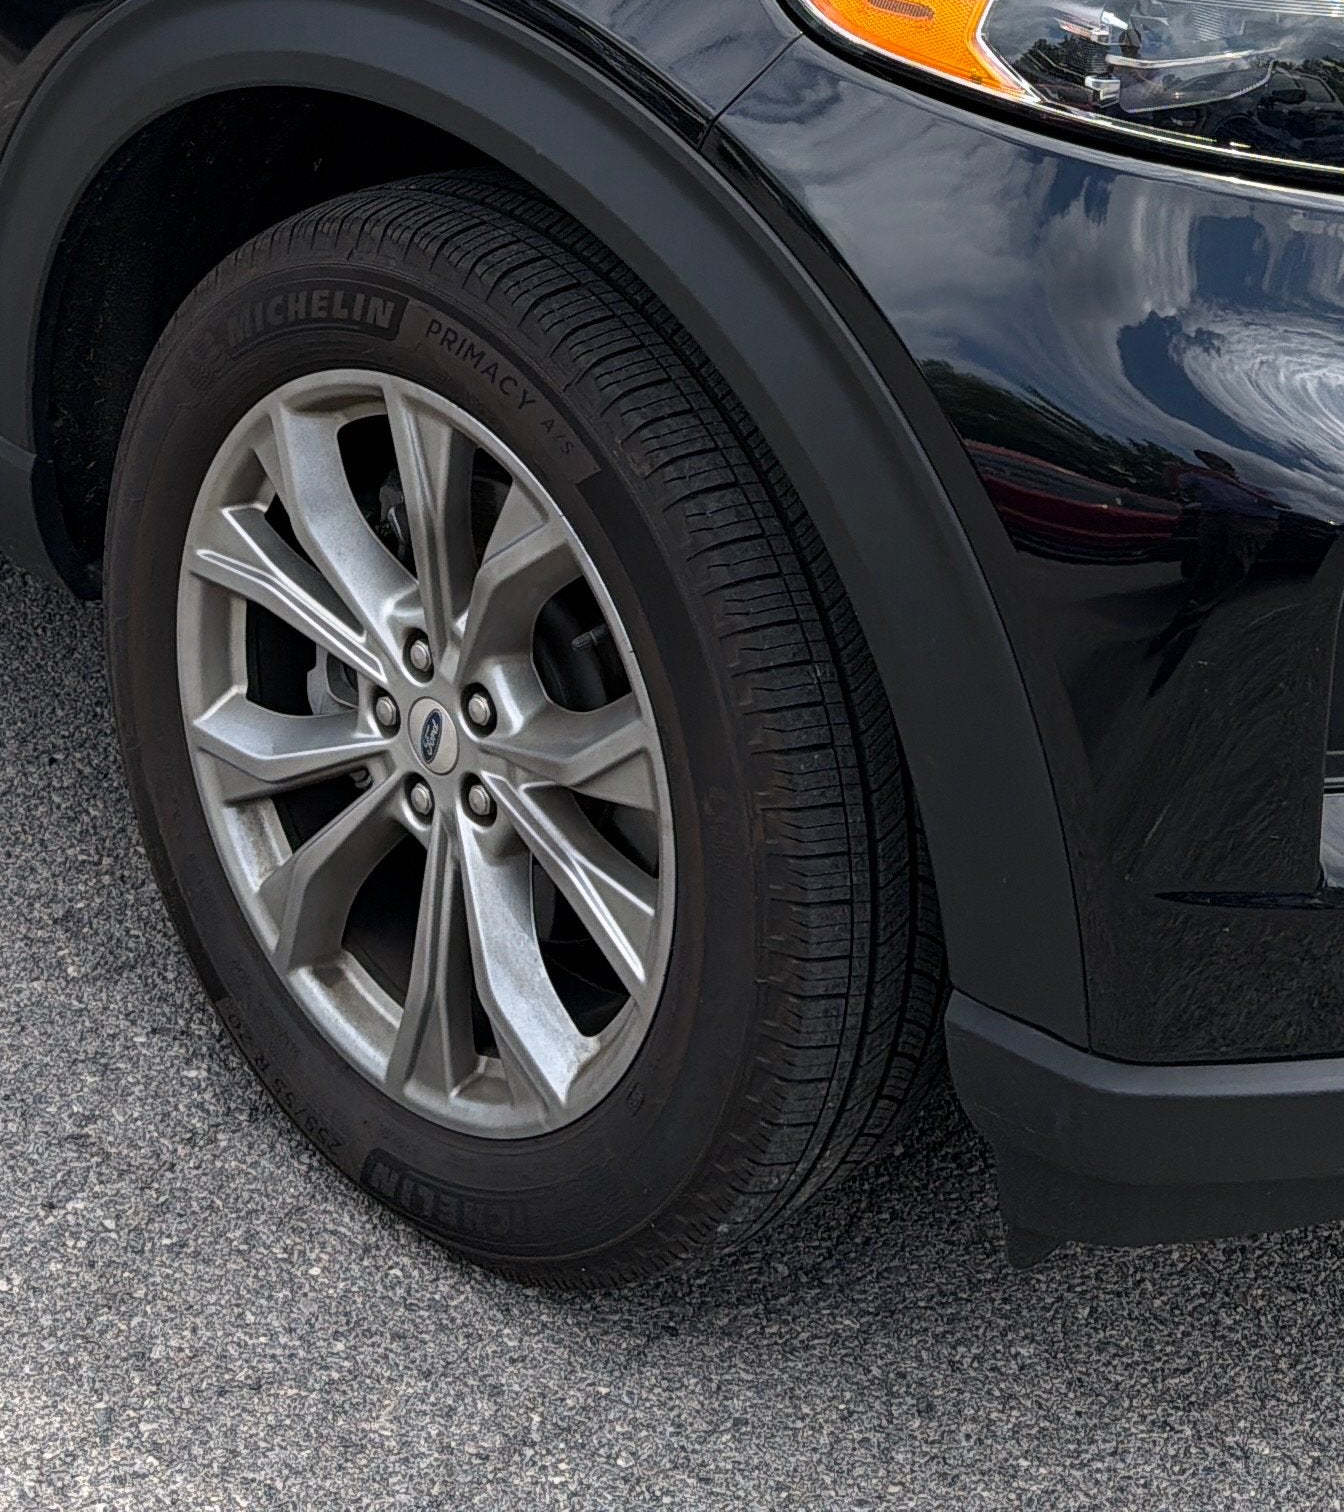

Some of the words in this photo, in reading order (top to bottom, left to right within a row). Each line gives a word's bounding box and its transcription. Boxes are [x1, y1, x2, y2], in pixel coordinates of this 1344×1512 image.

[229, 290, 396, 344] MICHELIN
[426, 320, 537, 409] PRIMACY
[541, 418, 575, 455] A/S
[423, 718, 439, 756] Ford
